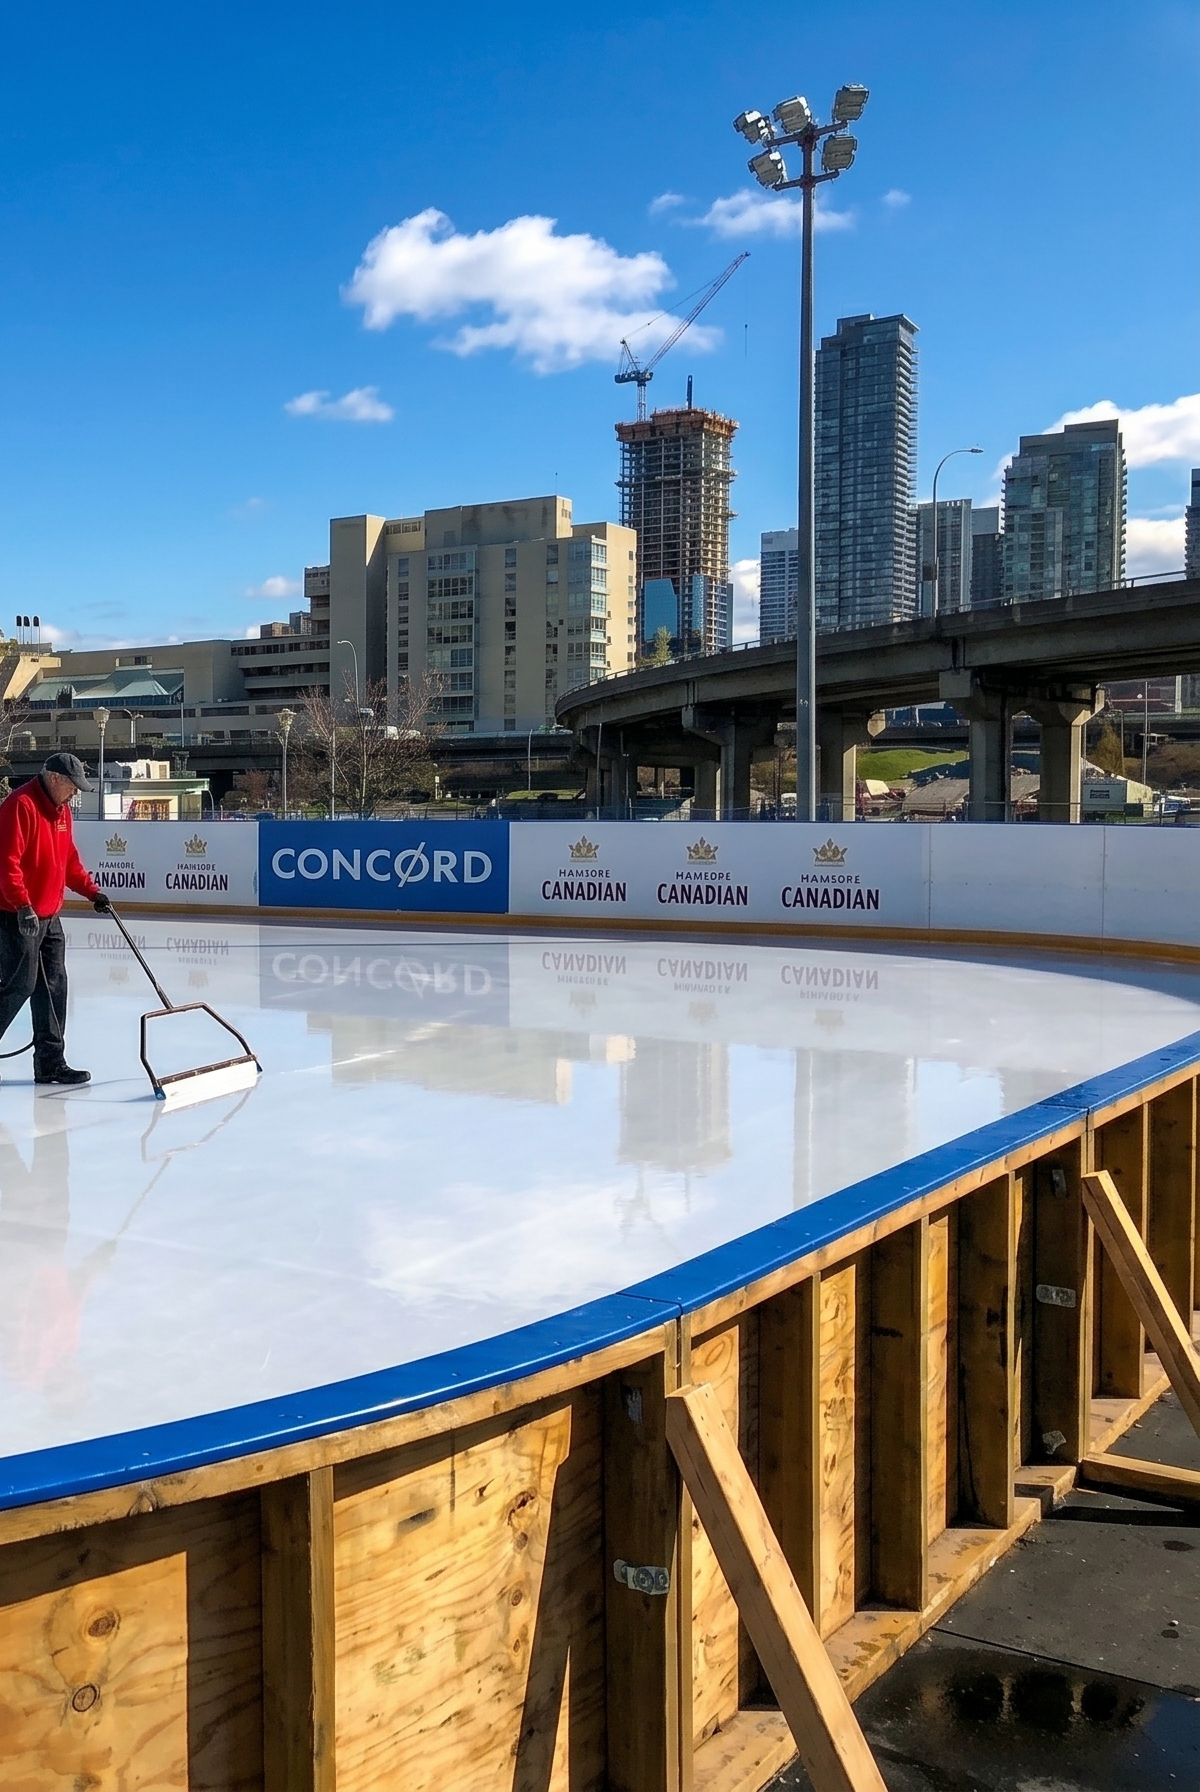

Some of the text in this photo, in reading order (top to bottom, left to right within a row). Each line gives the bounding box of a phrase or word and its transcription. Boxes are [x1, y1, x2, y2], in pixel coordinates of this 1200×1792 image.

[88, 870, 145, 889] ANADIAN
[165, 872, 228, 891] CANADIAN
[541, 880, 627, 902] CANADIAN
[657, 883, 749, 906] CANADIAN
[781, 886, 880, 910] CANADIAN
